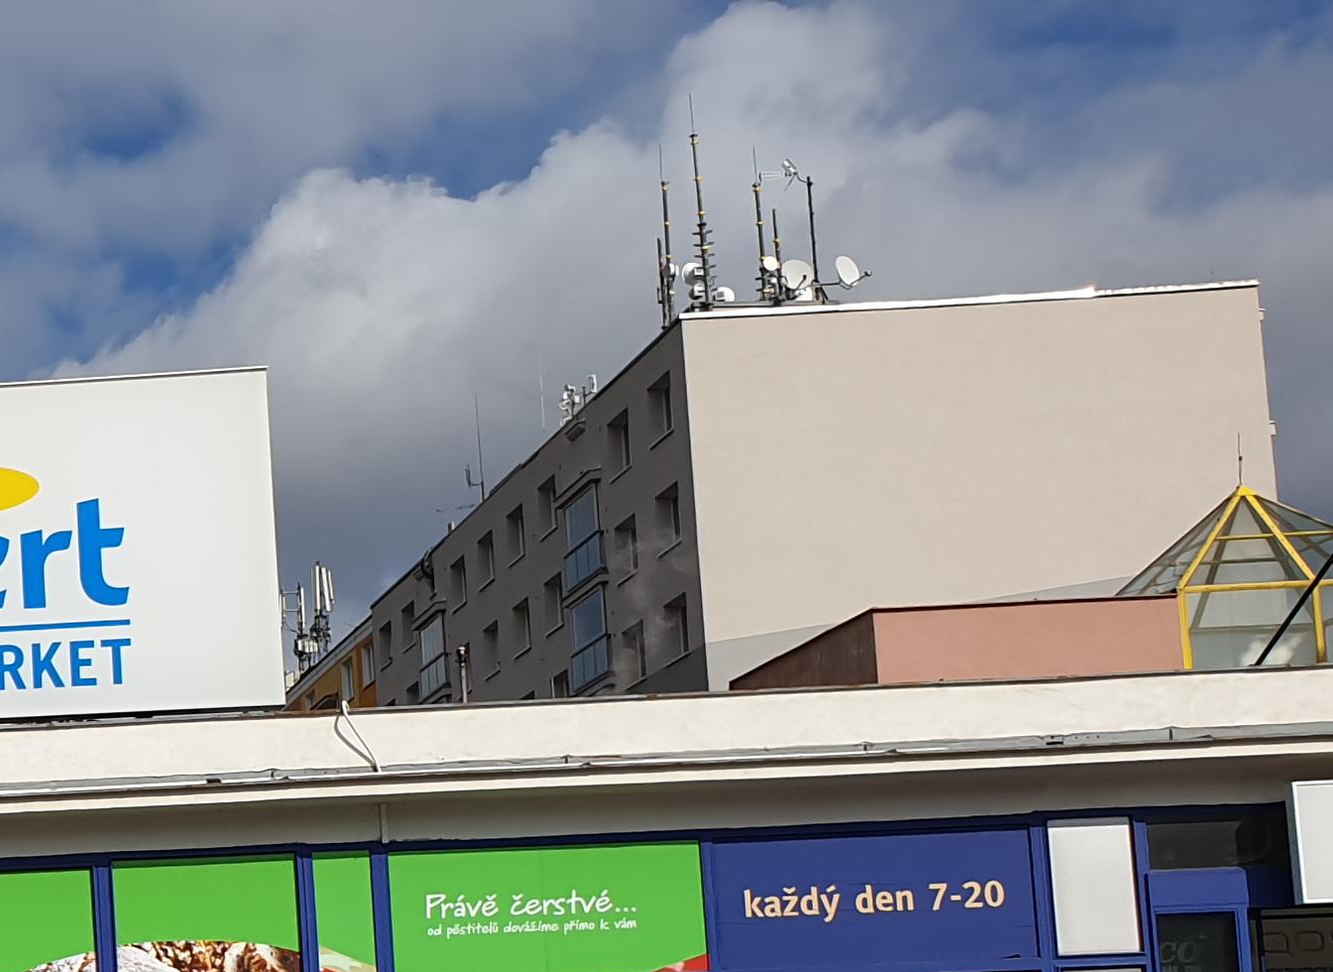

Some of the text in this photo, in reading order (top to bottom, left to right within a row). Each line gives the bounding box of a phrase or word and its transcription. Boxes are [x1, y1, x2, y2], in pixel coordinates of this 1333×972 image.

[425, 894, 499, 919] Právě
[743, 880, 1005, 923] každý den 7-20
[427, 918, 637, 939] od pěstitelů dovážíme přímo k vám
